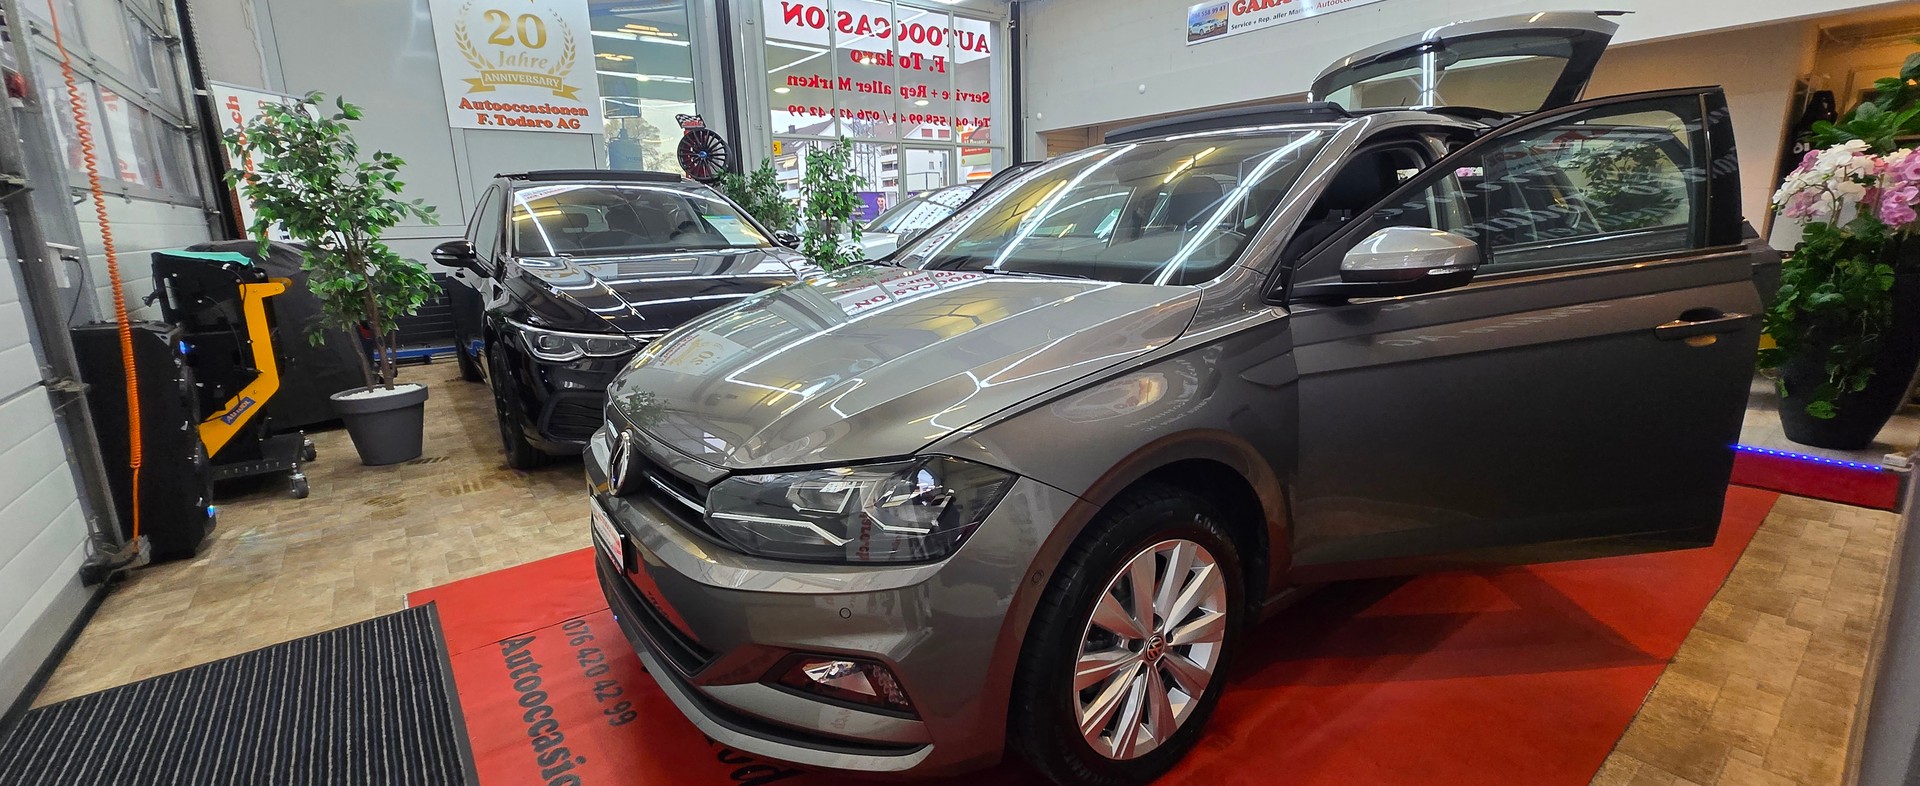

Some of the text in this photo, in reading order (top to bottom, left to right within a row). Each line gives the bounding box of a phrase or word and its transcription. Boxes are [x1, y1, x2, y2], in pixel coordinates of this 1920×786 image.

[483, 9, 547, 49] 20
[1231, 20, 1252, 30] Service
[1258, 16, 1272, 25] Rep.
[1272, 12, 1287, 20] aller
[499, 51, 549, 69] Jahre
[484, 73, 560, 88] ANNIVERSARY
[459, 97, 589, 116] Autooccasionen
[476, 113, 581, 129] F. Todaro AG
[561, 619, 637, 727] 076 420 42 99
